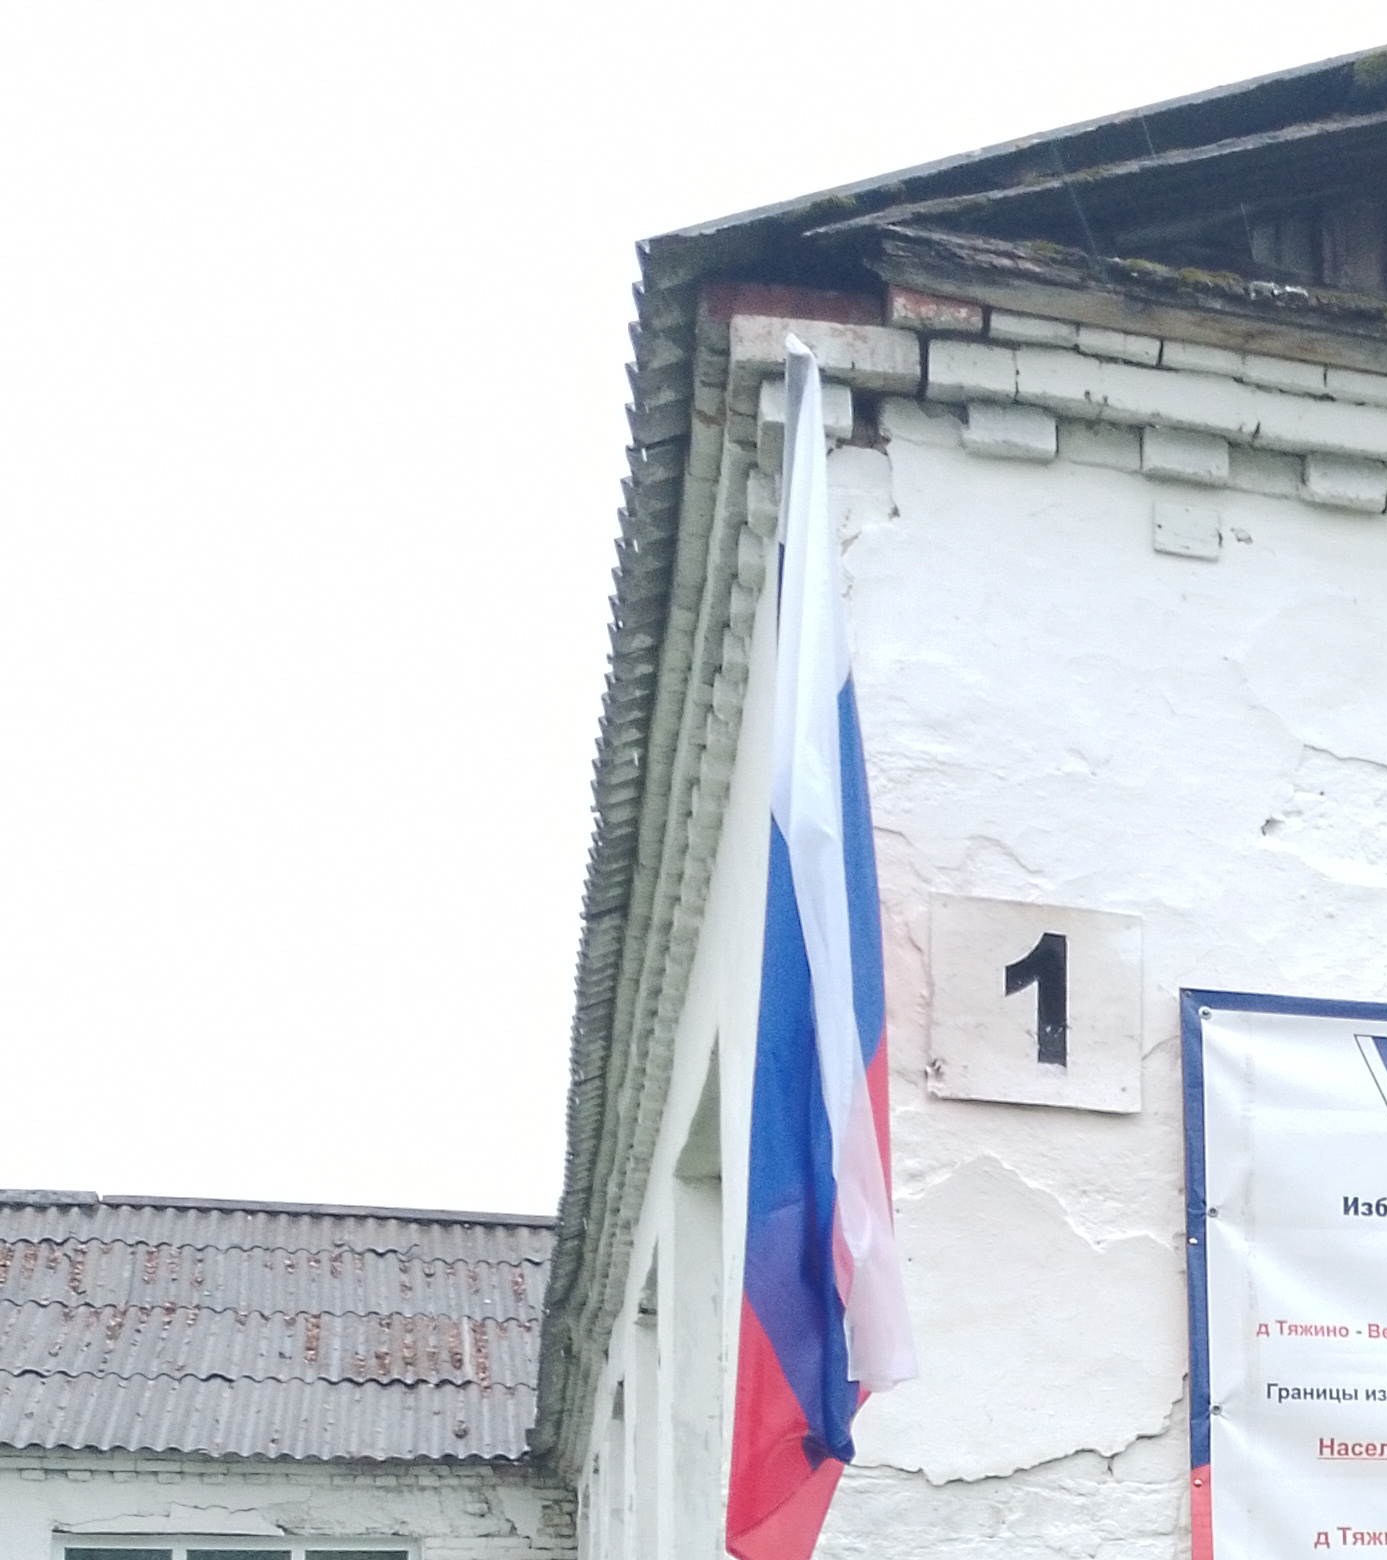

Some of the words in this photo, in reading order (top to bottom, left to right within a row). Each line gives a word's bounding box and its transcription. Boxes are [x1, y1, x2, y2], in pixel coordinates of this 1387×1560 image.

[1004, 931, 1069, 1068] 1
[1256, 1324, 1270, 1337] д
[1276, 1320, 1349, 1337] Тяжино
[1267, 1383, 1358, 1404] Границы
[1314, 1532, 1330, 1549] д
